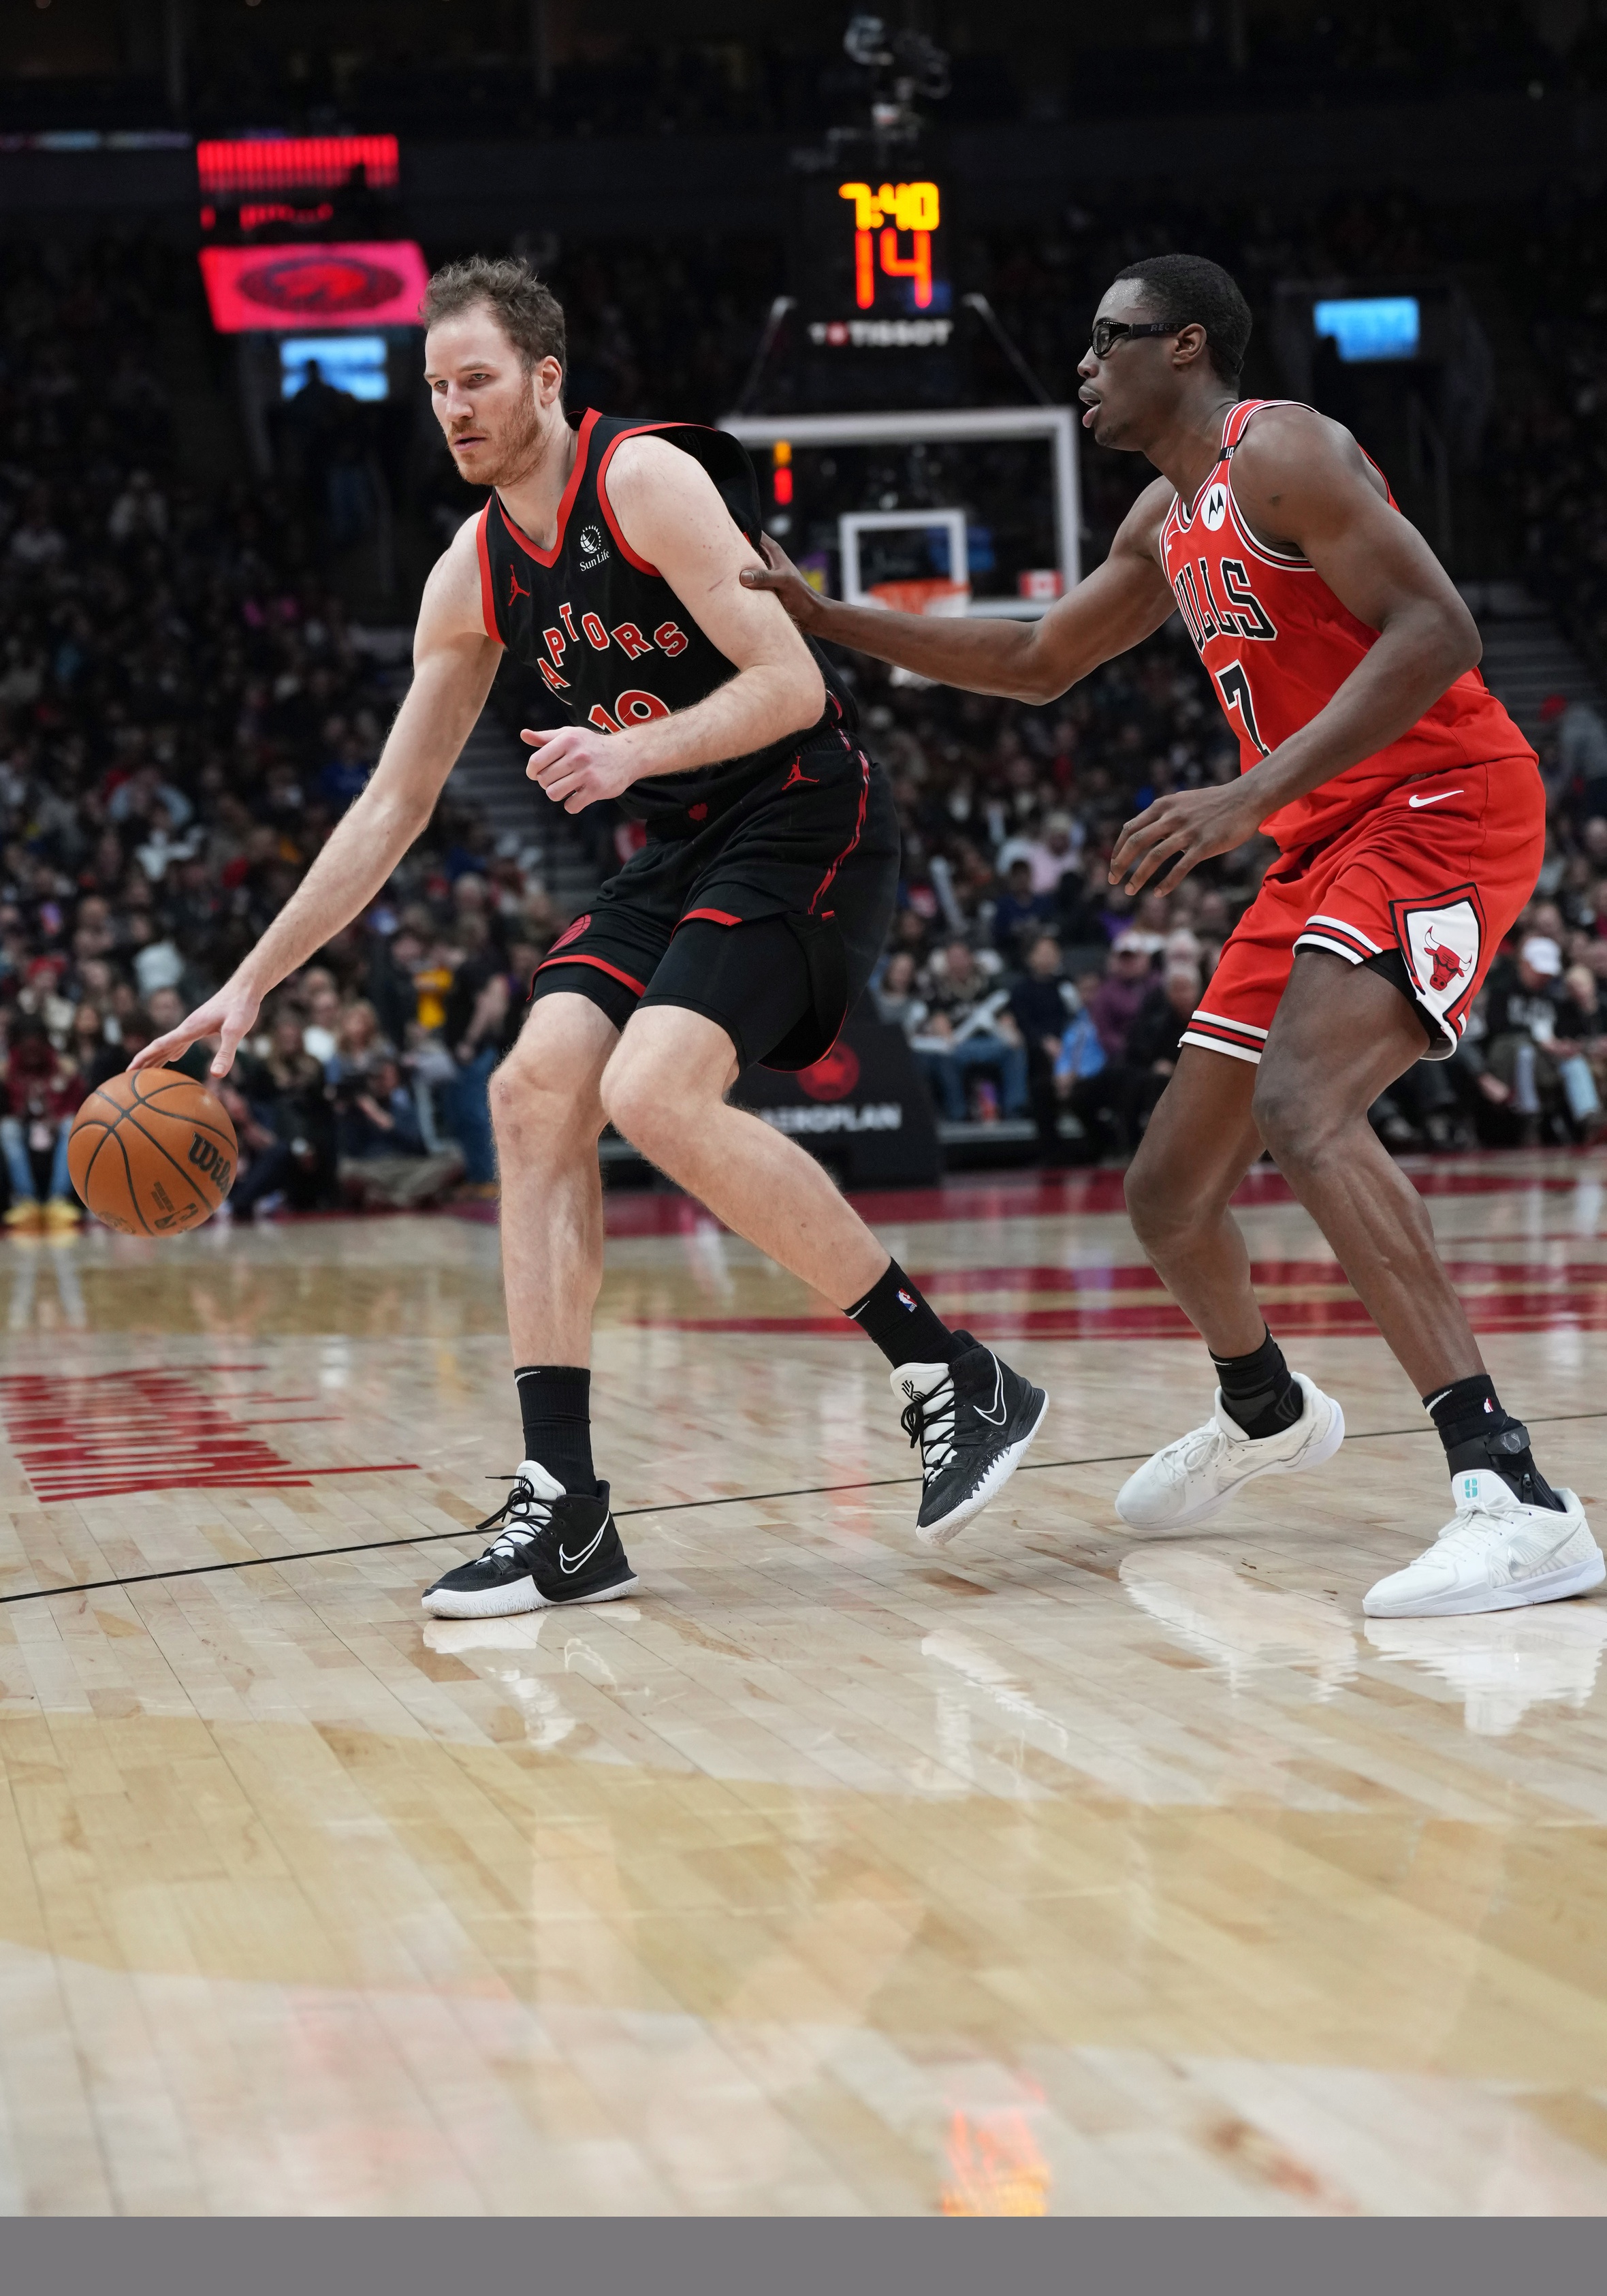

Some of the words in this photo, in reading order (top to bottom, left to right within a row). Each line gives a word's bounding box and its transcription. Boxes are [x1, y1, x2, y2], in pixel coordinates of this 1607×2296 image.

[839, 182, 939, 231] 7:40
[855, 227, 932, 309] 14
[579, 559, 596, 571] Sun
[596, 549, 610, 564] Life
[1173, 556, 1279, 655] ULLS
[537, 602, 689, 706] APTORS
[1215, 659, 1272, 758] 7
